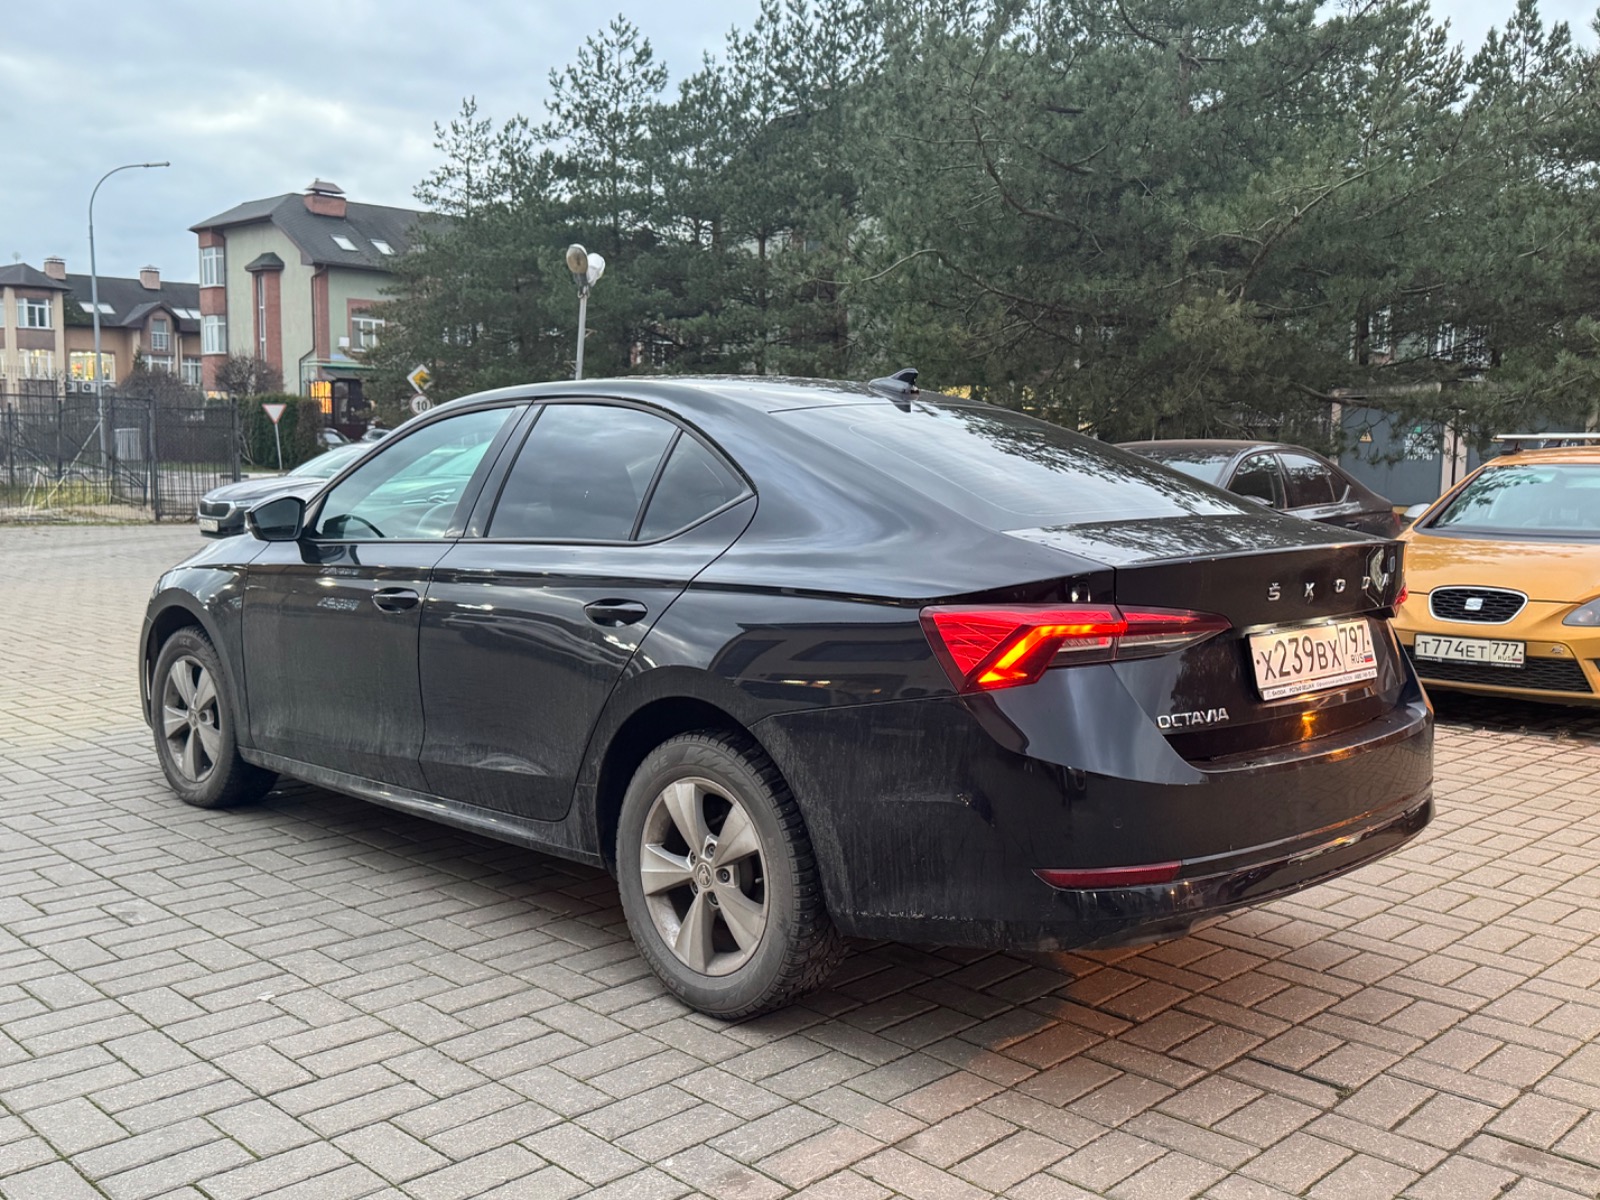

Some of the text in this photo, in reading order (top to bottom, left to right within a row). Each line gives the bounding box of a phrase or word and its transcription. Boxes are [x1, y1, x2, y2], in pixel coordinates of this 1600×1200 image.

[416, 400, 428, 411] 10
[1260, 635, 1342, 680] Х239ВХ
[1339, 624, 1366, 655] 797
[1351, 654, 1364, 664] RUS
[1421, 638, 1519, 659] Т774ЕТ 777
[1156, 707, 1230, 729] OCTAVIA
